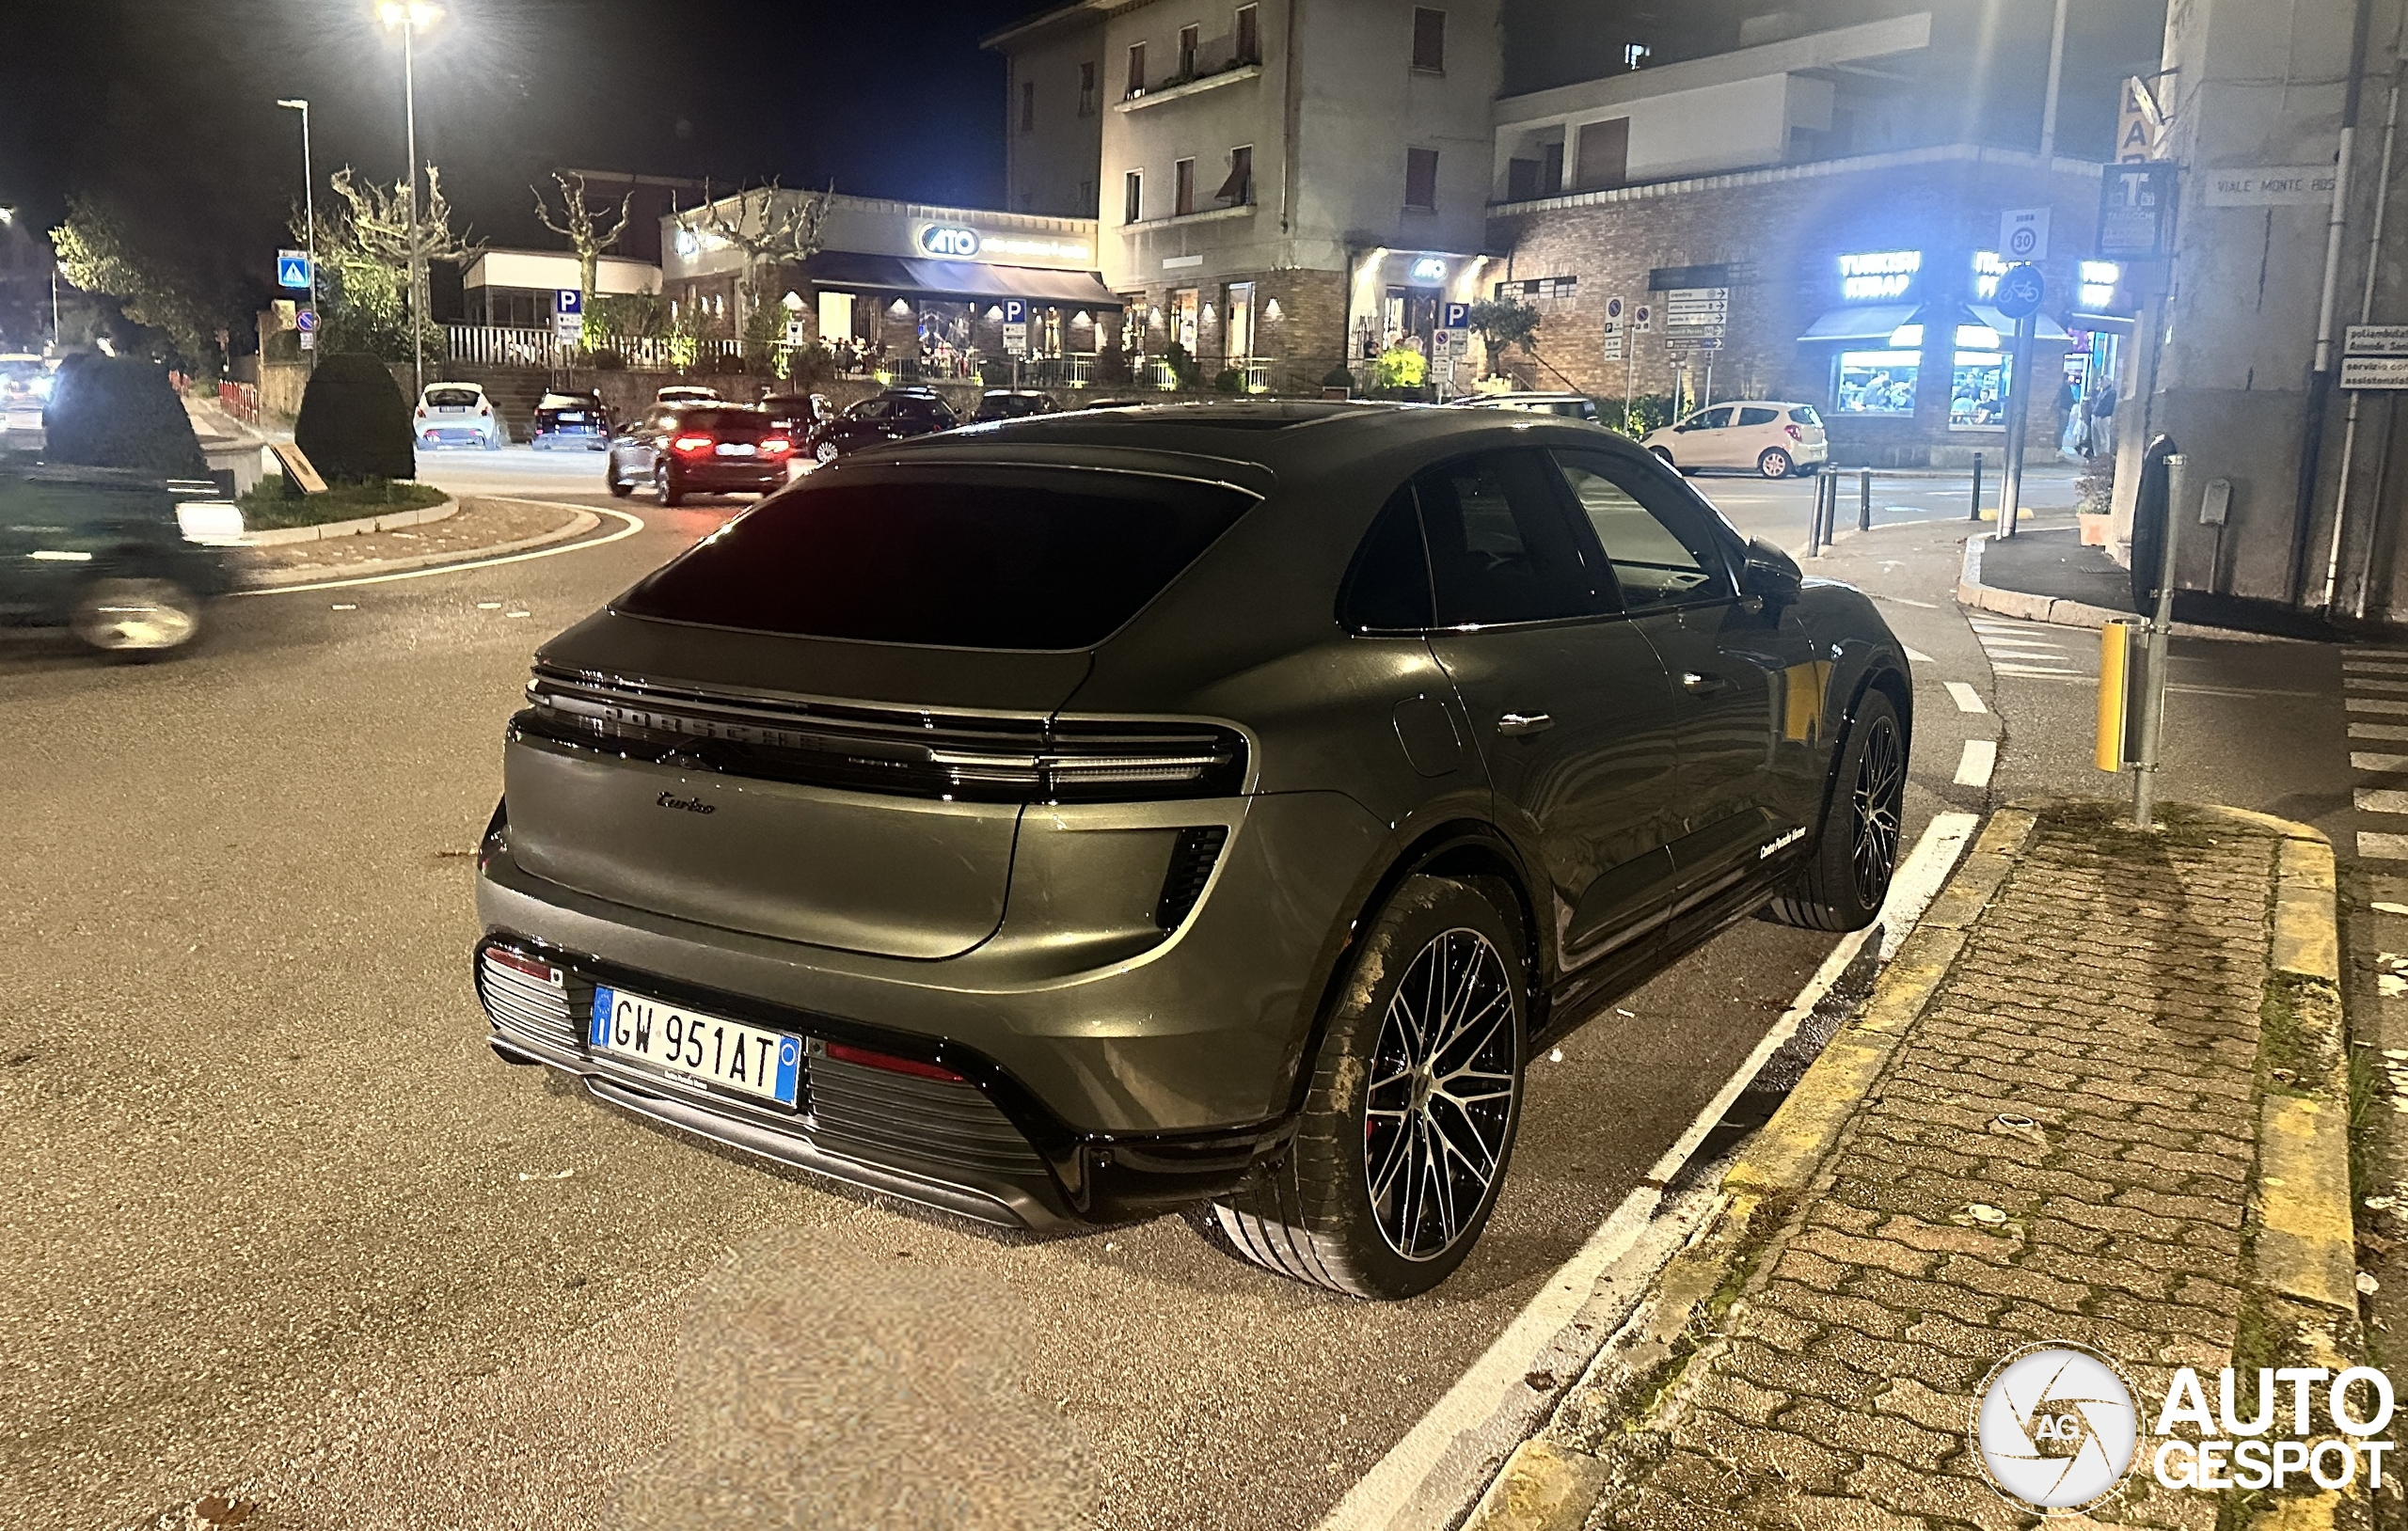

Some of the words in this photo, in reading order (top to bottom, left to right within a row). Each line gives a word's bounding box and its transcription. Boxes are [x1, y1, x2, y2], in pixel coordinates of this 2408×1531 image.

[2217, 180, 2252, 192] VIALE
[2260, 179, 2302, 192] MONTE
[928, 229, 975, 254] ATO
[2017, 234, 2031, 248] 30
[1840, 250, 1921, 276] TURKISH
[561, 292, 577, 311] P
[1006, 302, 1022, 322] P
[1449, 305, 1465, 326] P
[2346, 363, 2388, 372] servizio
[615, 1001, 653, 1054] GW
[666, 1015, 773, 1087] 951AT
